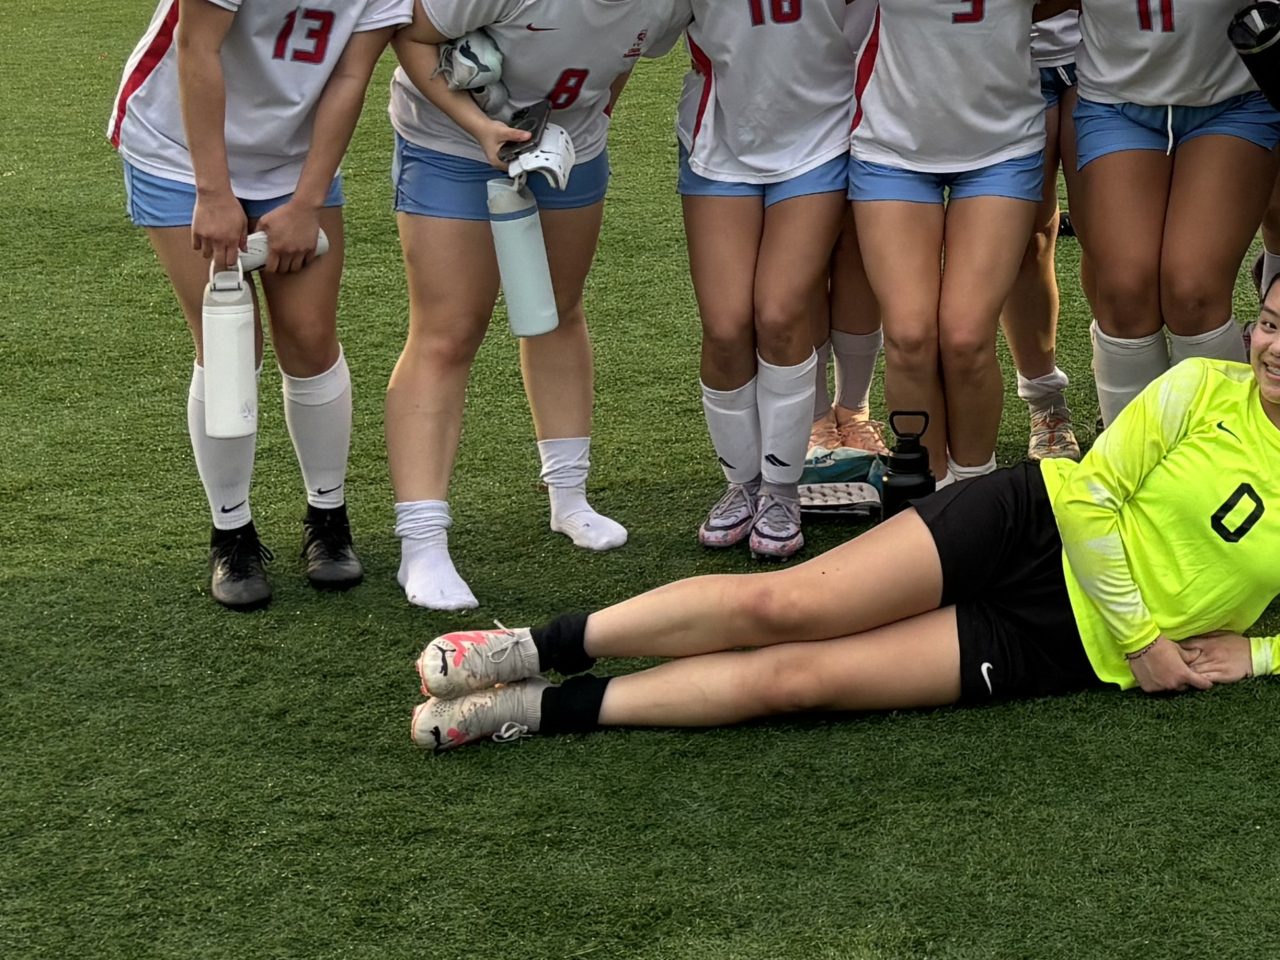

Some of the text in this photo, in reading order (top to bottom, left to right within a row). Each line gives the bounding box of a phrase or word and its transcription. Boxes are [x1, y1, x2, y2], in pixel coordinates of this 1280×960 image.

[271, 6, 336, 65] 13
[547, 67, 590, 110] 8
[1210, 481, 1265, 543] 0
